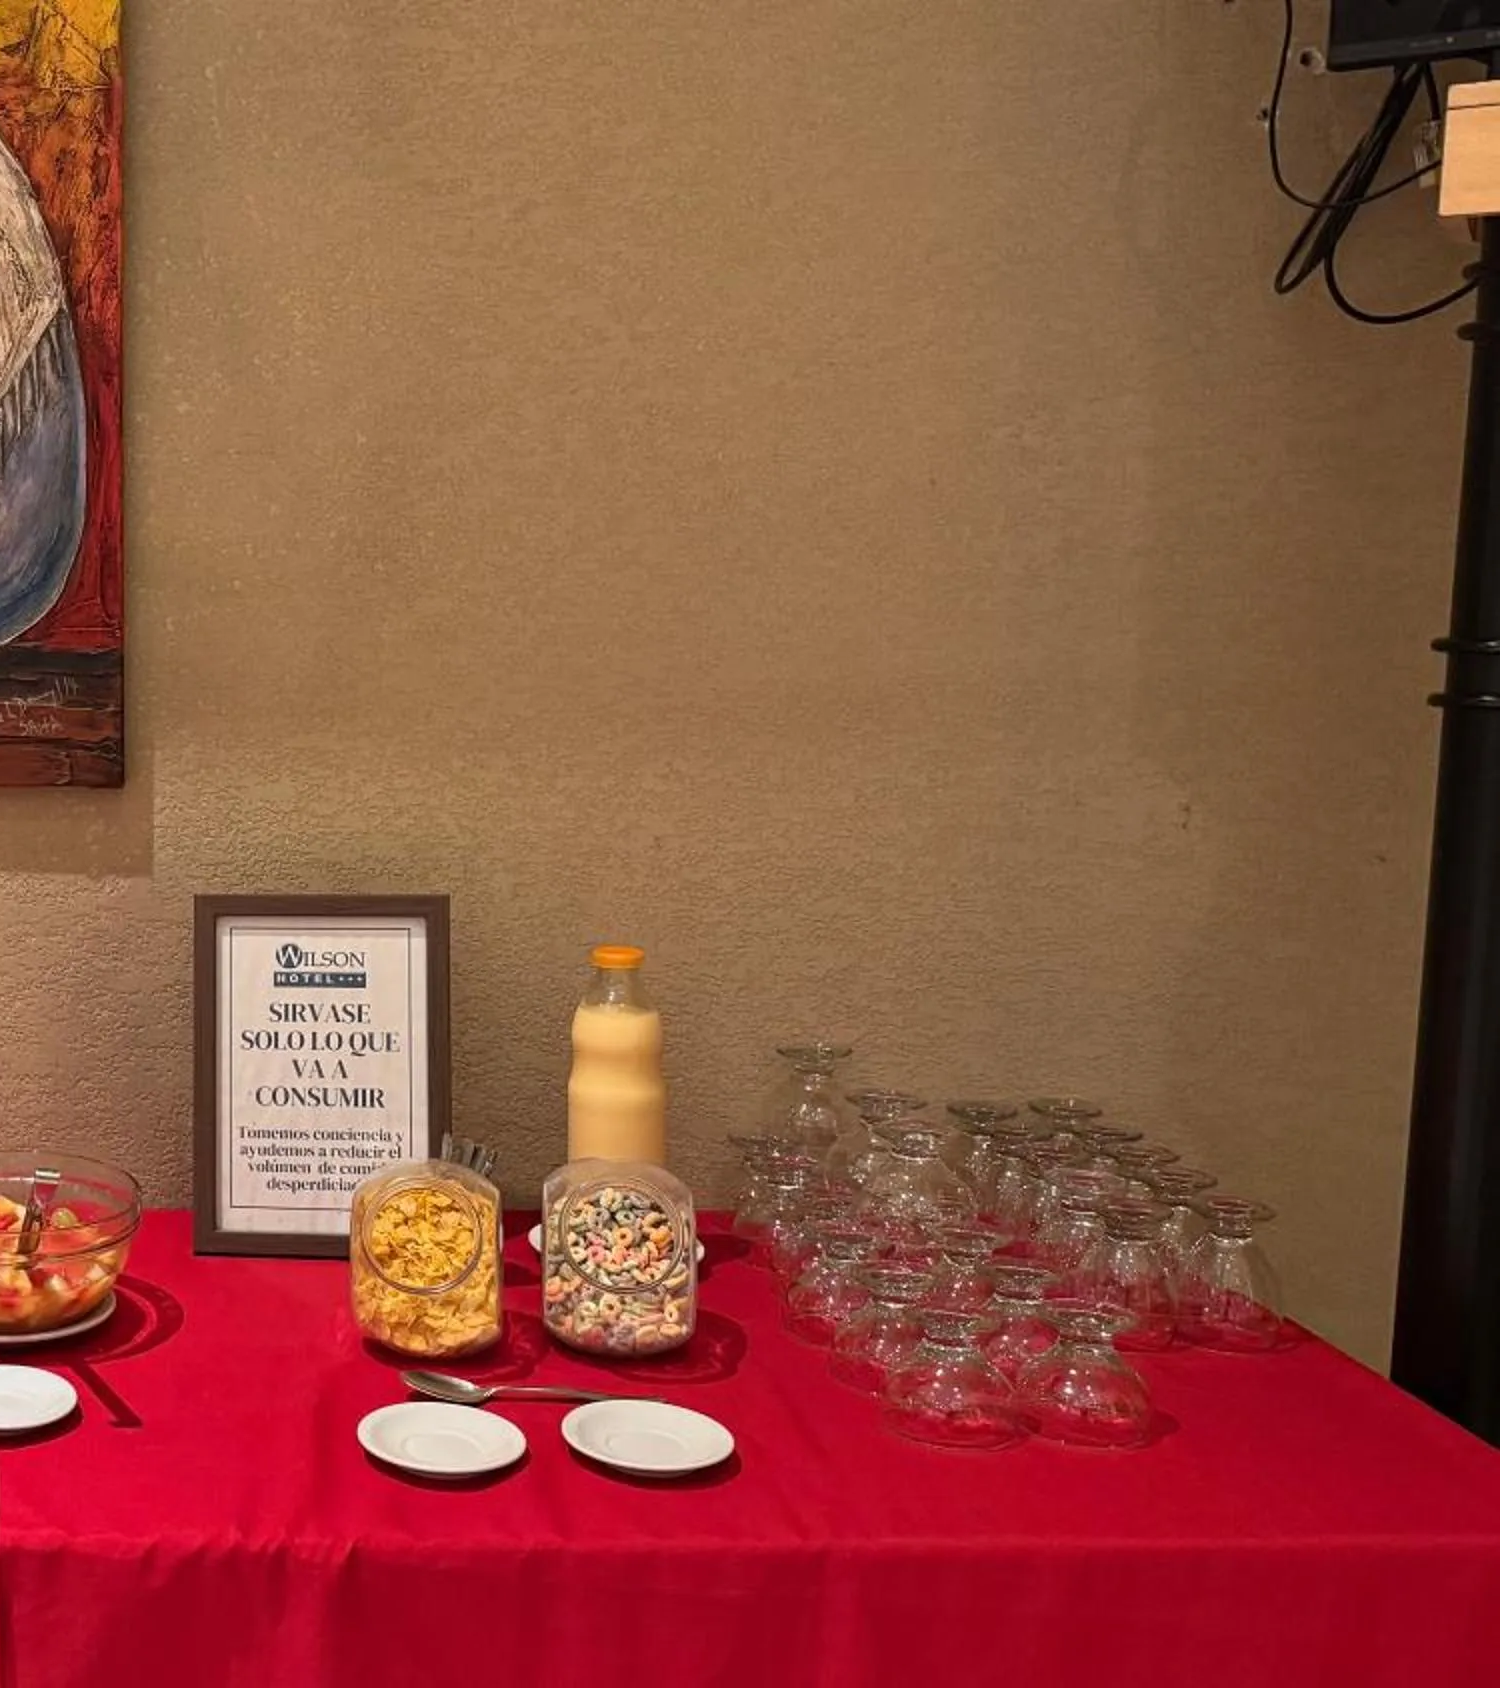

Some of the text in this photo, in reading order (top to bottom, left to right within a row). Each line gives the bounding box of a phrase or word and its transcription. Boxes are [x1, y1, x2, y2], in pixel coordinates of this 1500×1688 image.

[276, 944, 366, 969] WILSON
[276, 973, 335, 984] HOTEL
[269, 1002, 372, 1024] SIRVASE
[241, 1030, 401, 1057] SOLO LO QUE
[292, 1059, 349, 1079] VA A
[255, 1086, 386, 1109] CONSUMIR
[238, 1126, 404, 1143] Tomemos conciencia y
[239, 1144, 402, 1160] ayudemos a reducir el
[318, 1162, 337, 1175] de
[339, 1162, 387, 1175] comi
[266, 1178, 361, 1194] desperdicia
